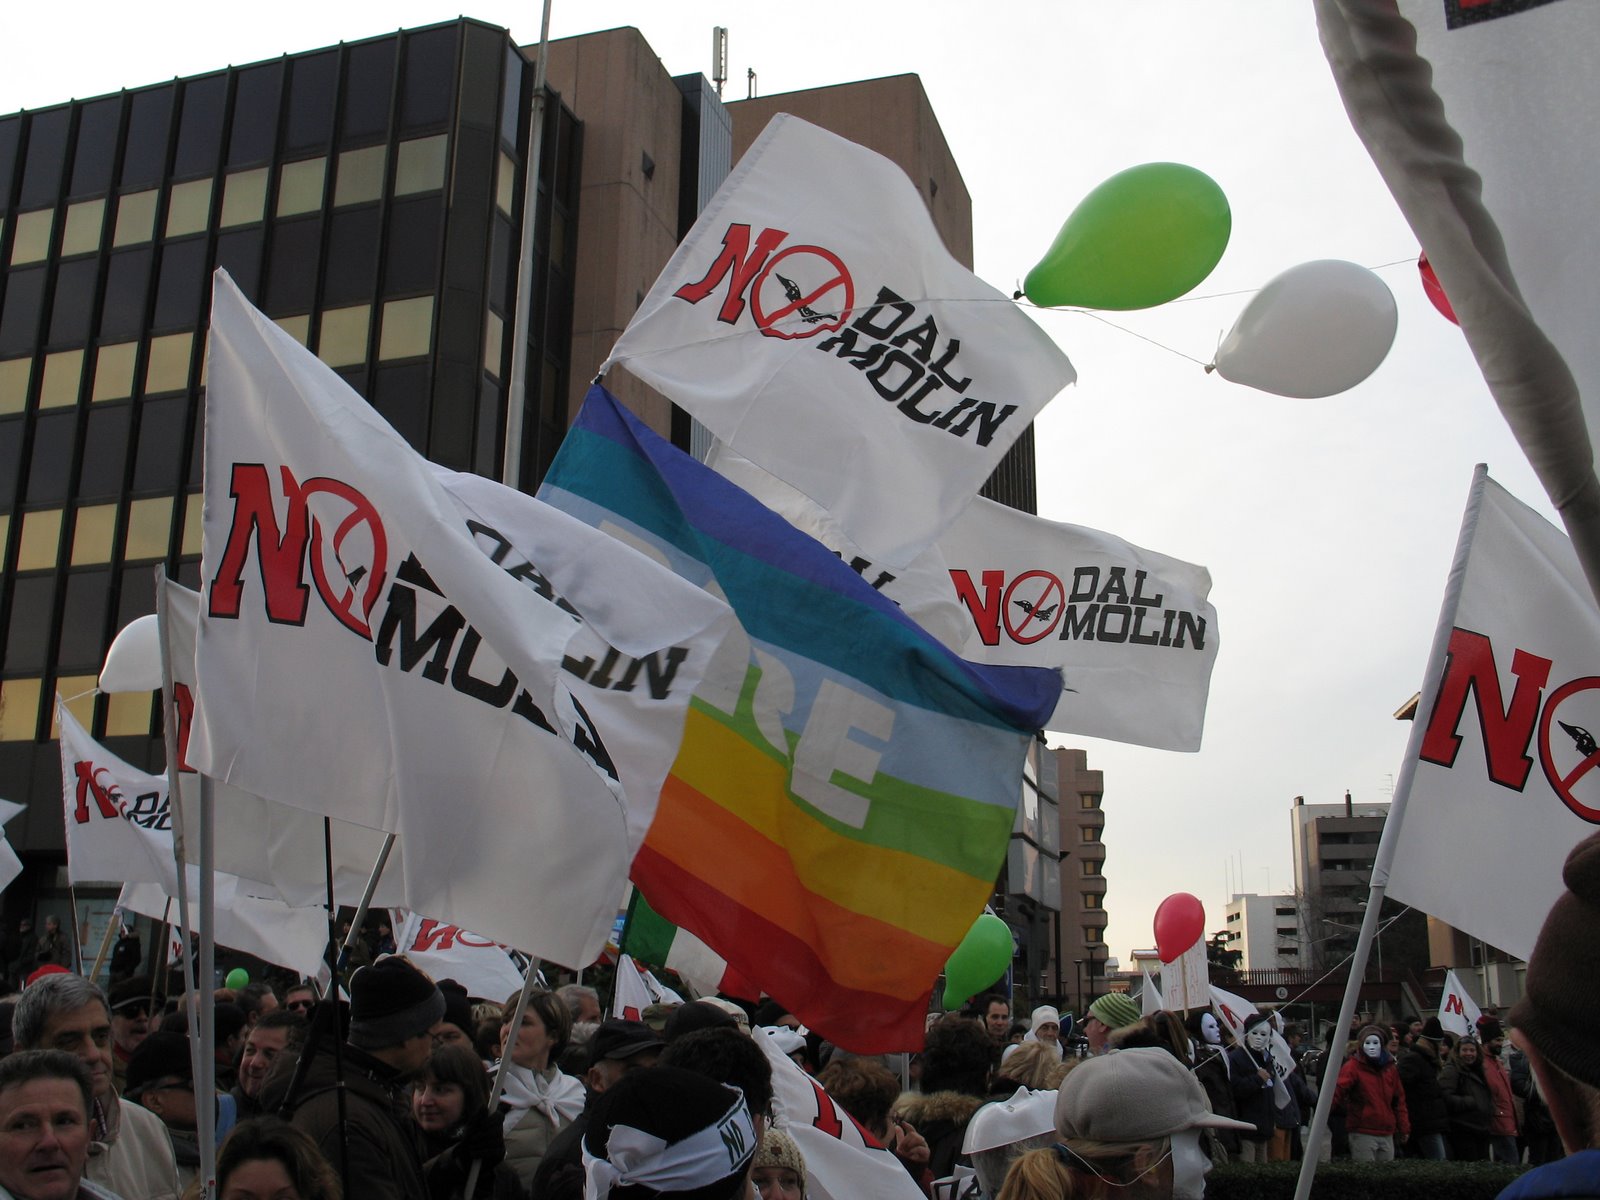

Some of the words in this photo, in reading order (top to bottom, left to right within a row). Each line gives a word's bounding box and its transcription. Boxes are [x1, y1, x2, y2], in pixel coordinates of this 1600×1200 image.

[672, 222, 854, 340] NO
[816, 327, 1019, 448] MOLIN
[851, 285, 972, 394] DAL
[207, 462, 388, 642] NO
[1068, 566, 1162, 608] DAL
[948, 568, 1065, 646] NO
[1058, 603, 1207, 651] MOLIN
